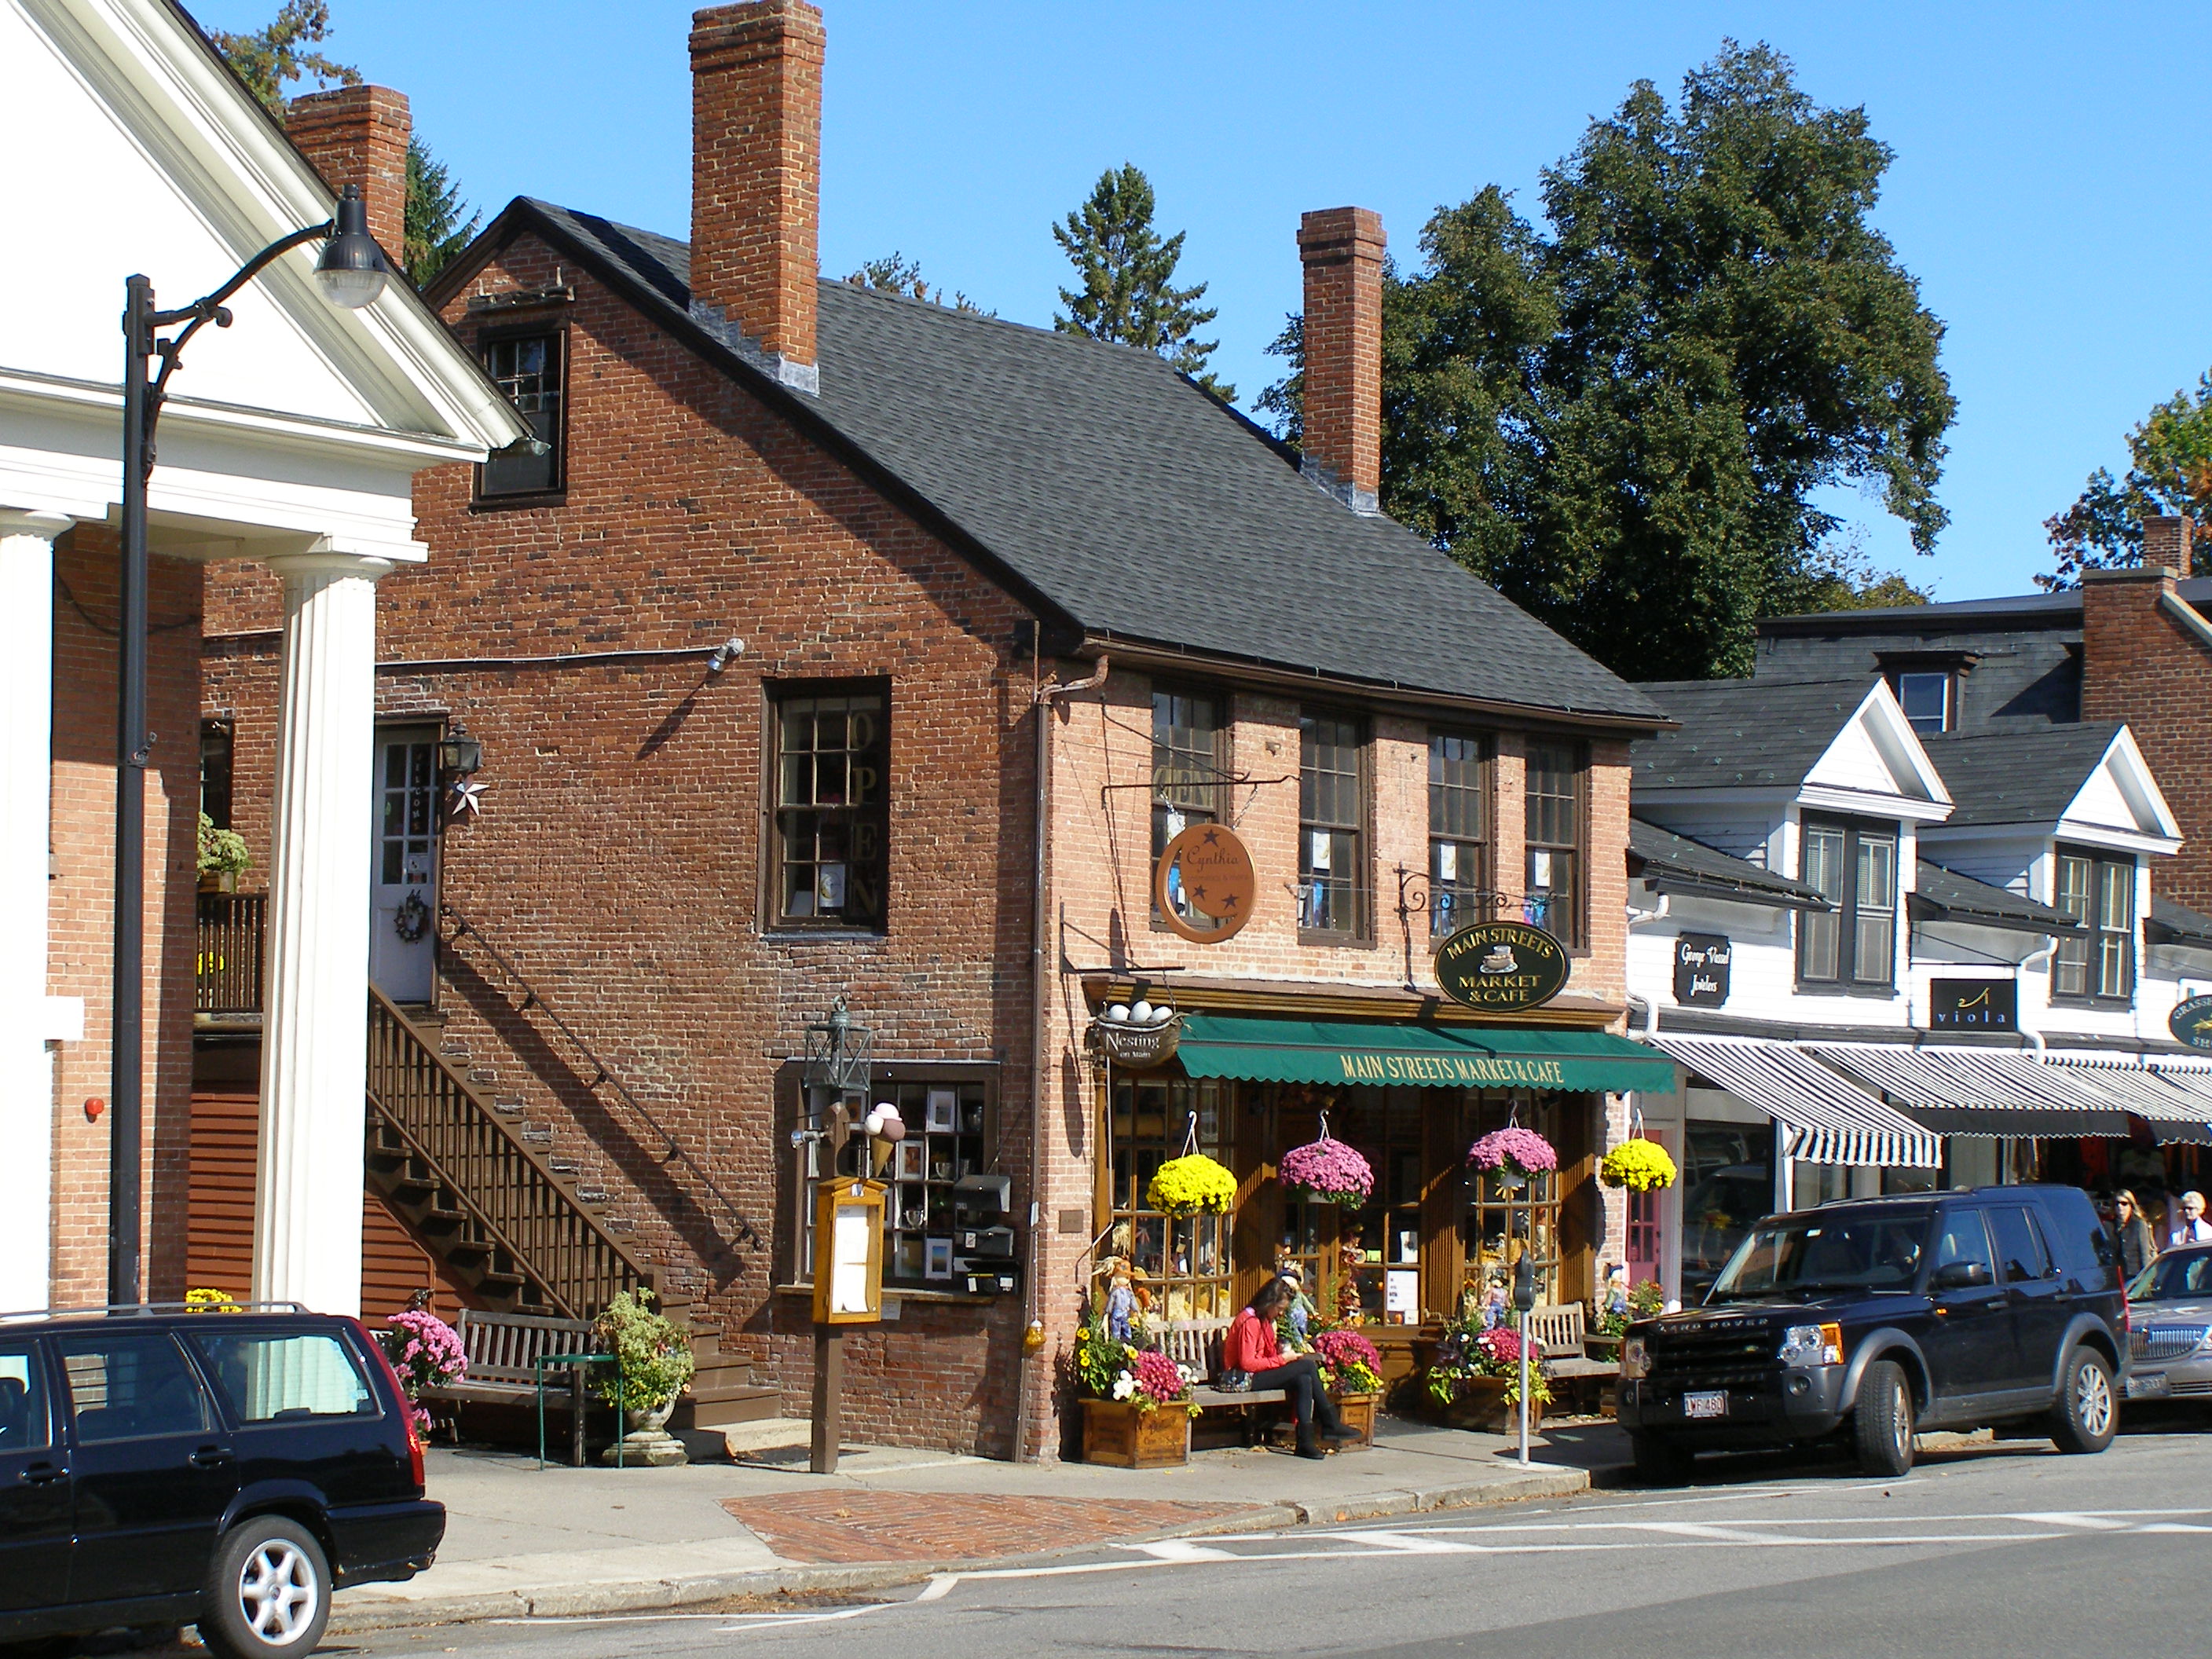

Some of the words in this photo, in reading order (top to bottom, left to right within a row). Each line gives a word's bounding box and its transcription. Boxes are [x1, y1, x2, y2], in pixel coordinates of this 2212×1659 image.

[850, 712, 877, 916] OPEN
[1187, 845, 1239, 872] Cynthia
[1447, 929, 1488, 960] MAIN
[1490, 928, 1555, 958] STREETS
[1459, 975, 1542, 988] MARKET
[1938, 1010, 2005, 1023] viola
[1106, 1032, 1160, 1052] Nesting
[2192, 1036, 2212, 1049] SH
[1340, 1055, 1385, 1079] MAIN
[1386, 1057, 1455, 1079] STREETS
[1659, 1323, 1701, 1333] LAND
[1709, 1318, 1768, 1330] ROVER
